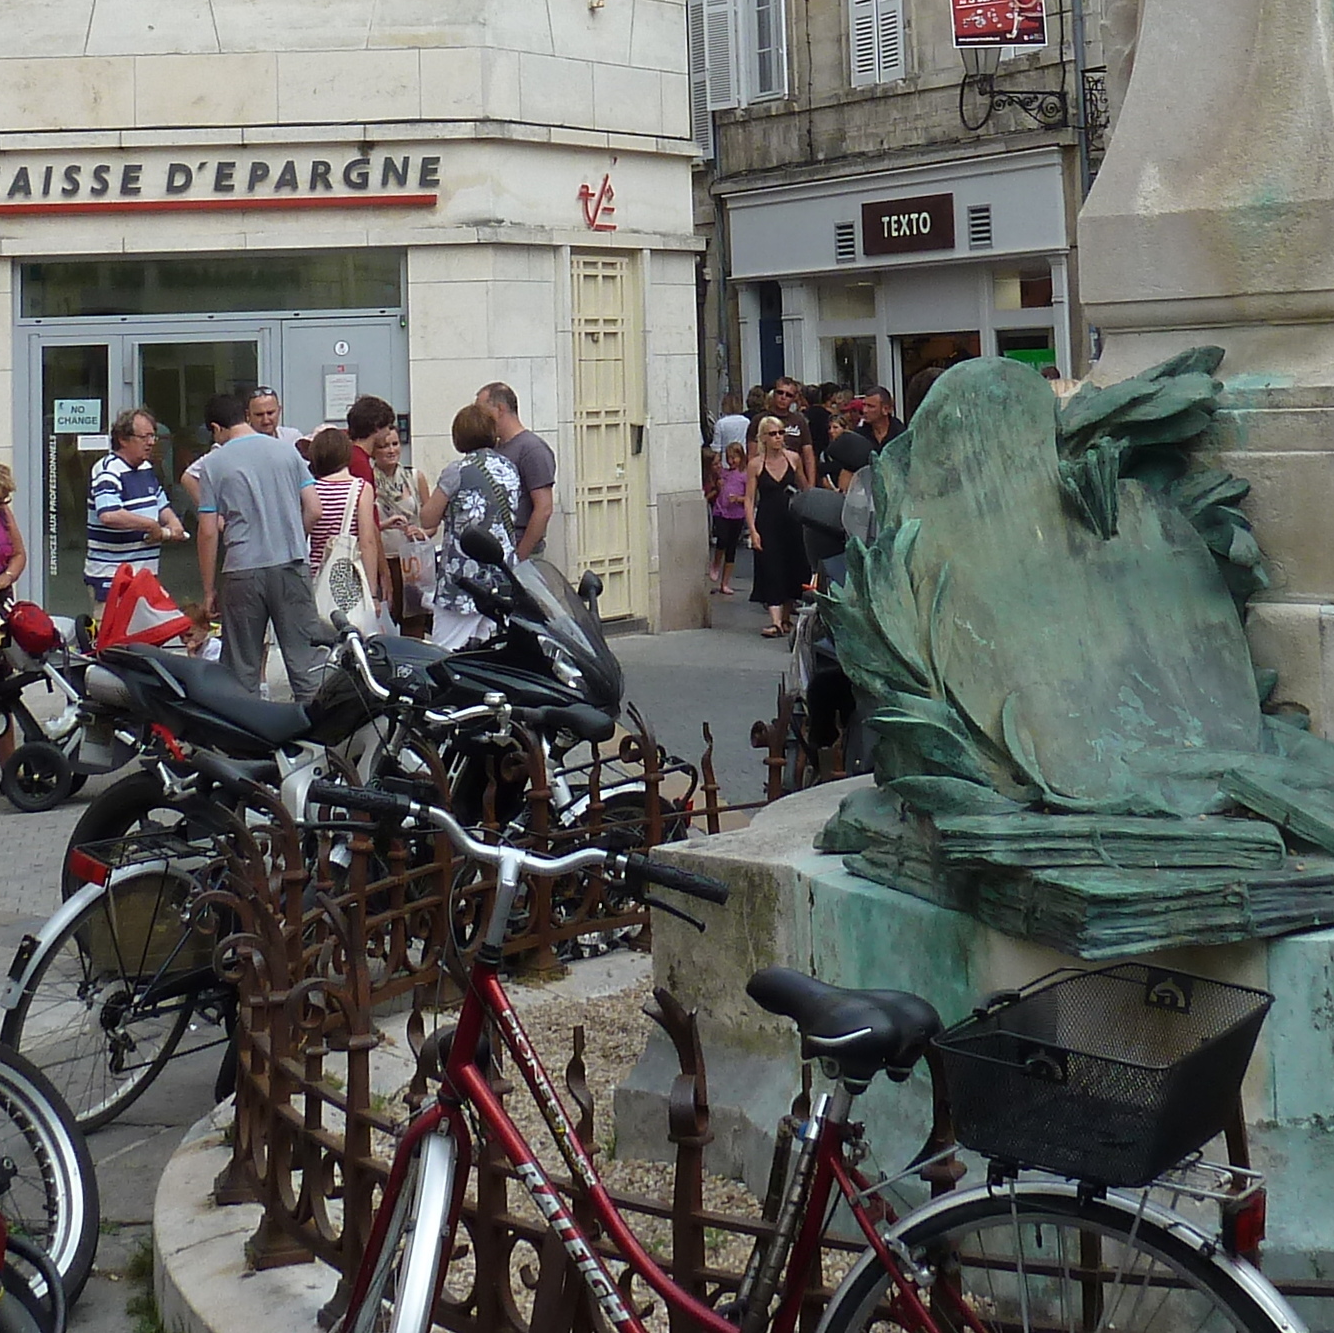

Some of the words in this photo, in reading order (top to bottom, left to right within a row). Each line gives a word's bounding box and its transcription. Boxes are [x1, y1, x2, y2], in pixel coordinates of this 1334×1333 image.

[881, 212, 931, 238] TEXTO
[70, 405, 86, 415] NO
[57, 417, 98, 426] CHANGE
[516, 1162, 630, 1323] RALEIGH
